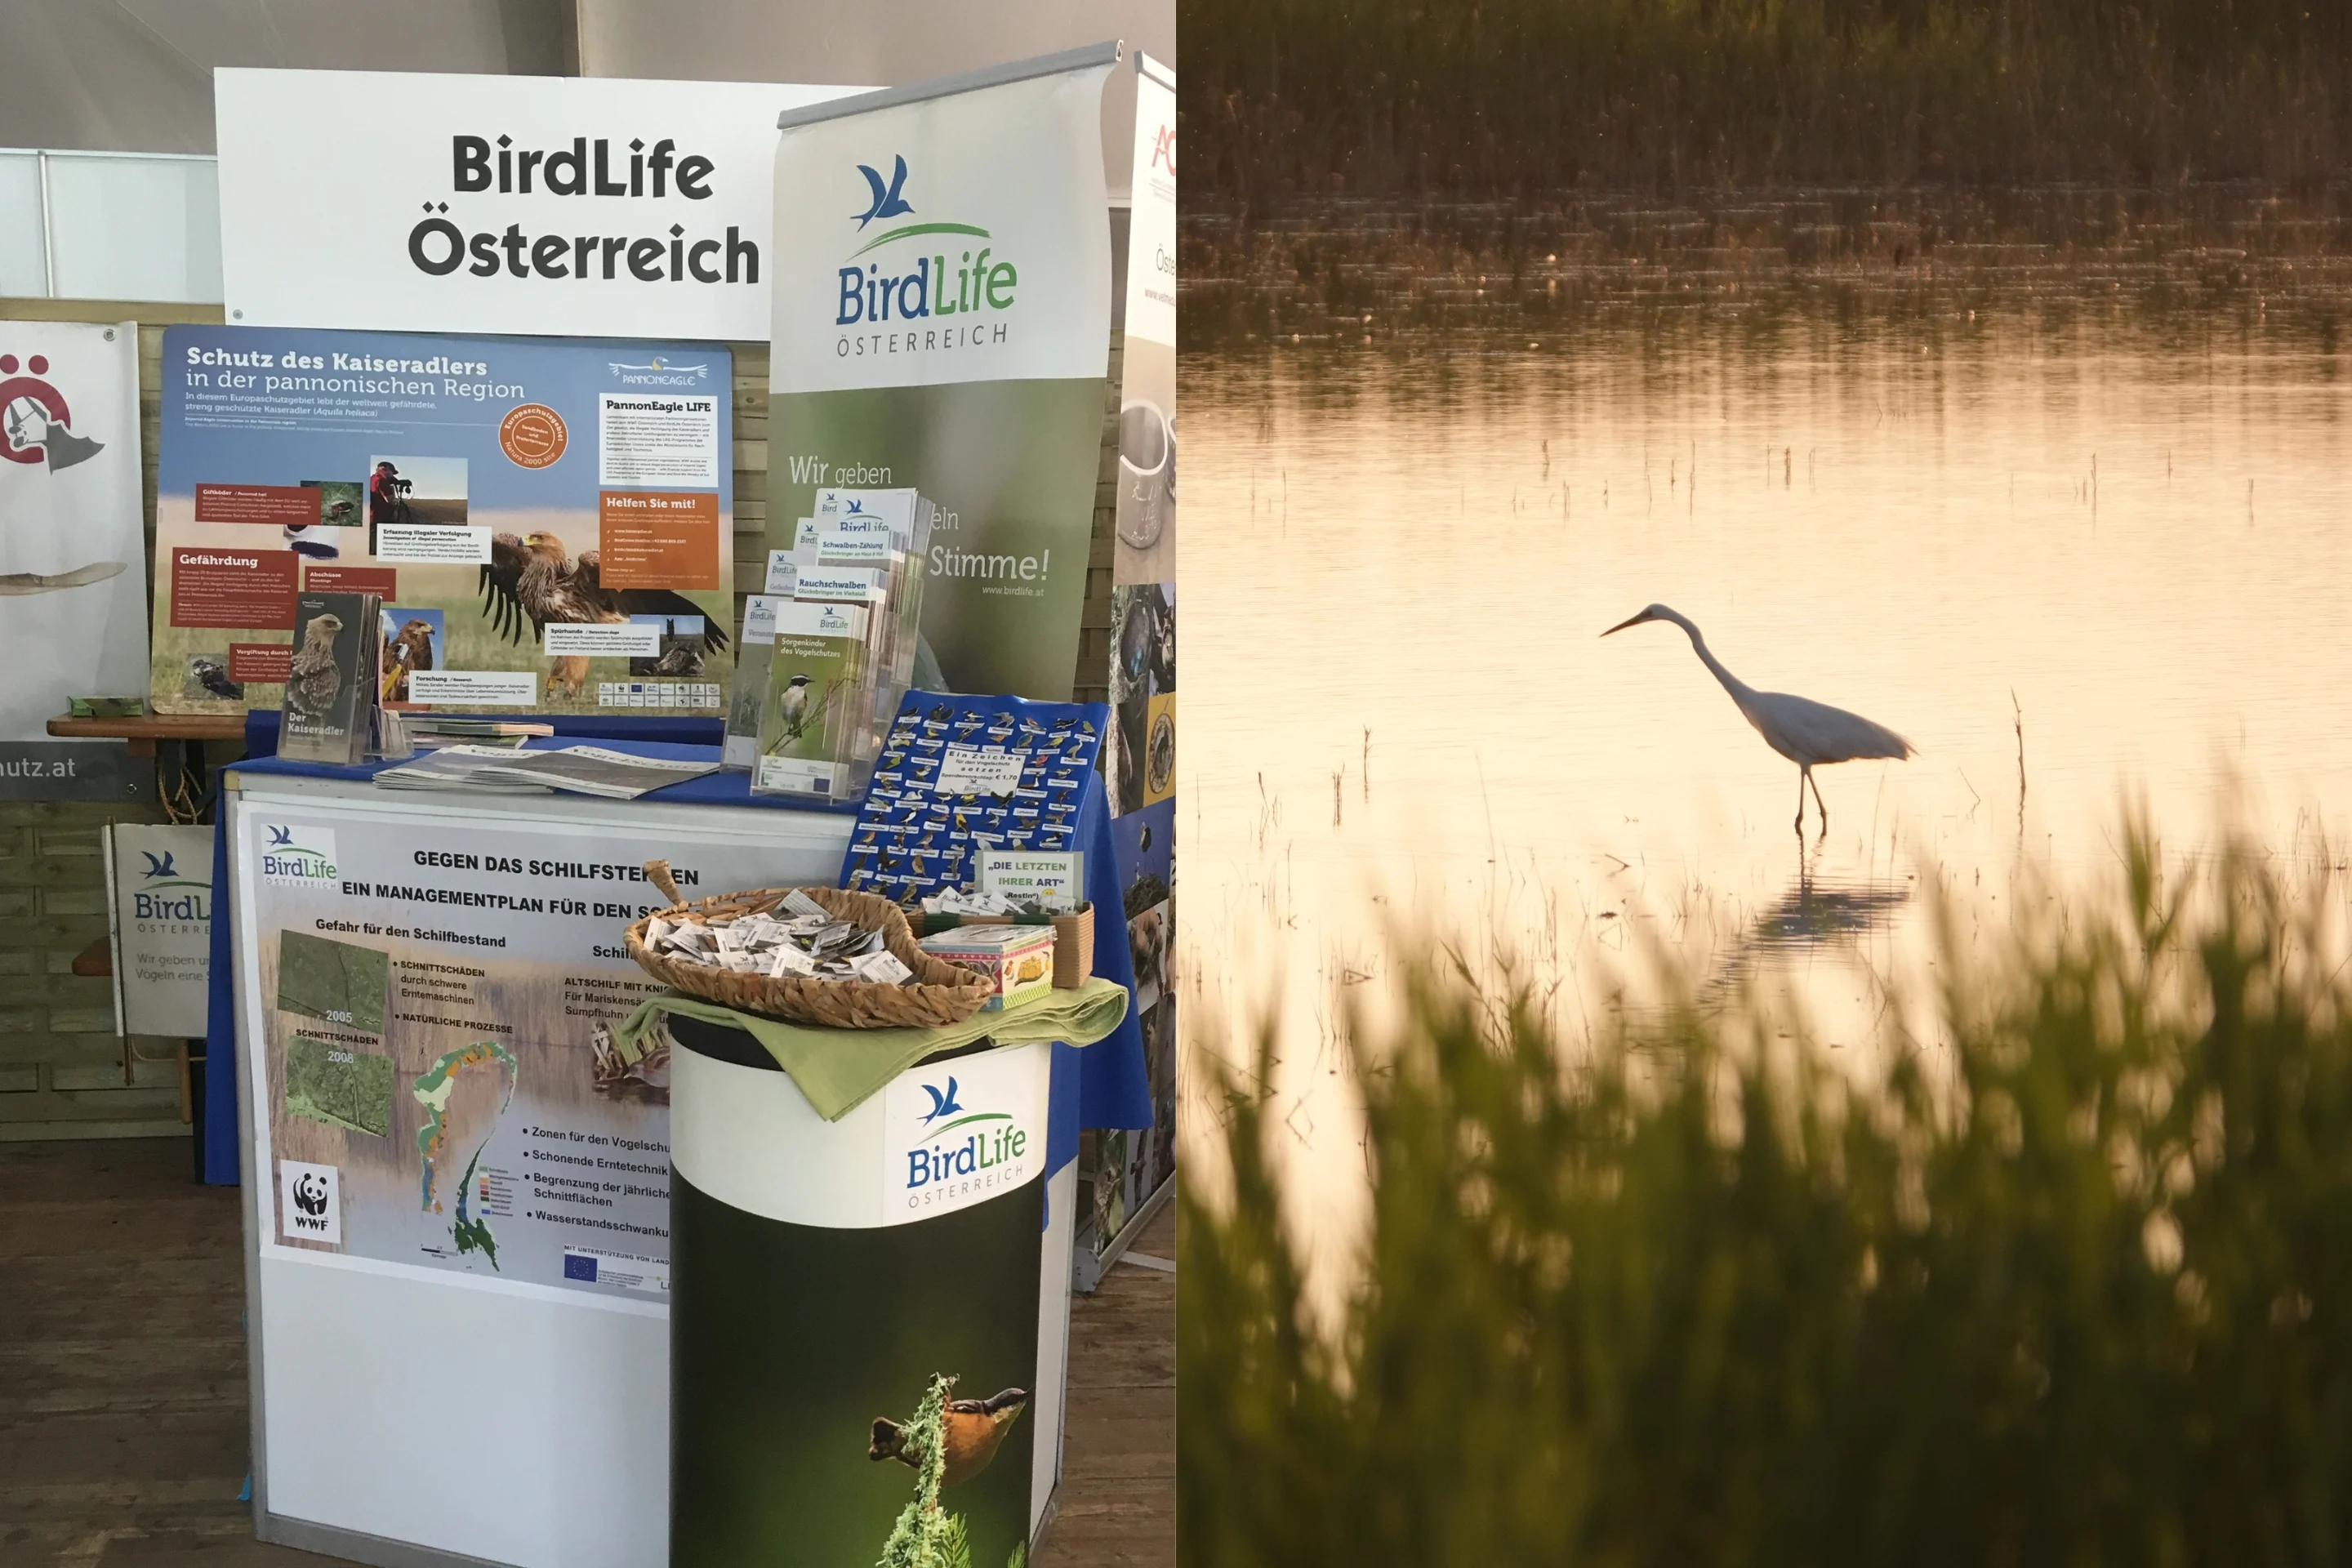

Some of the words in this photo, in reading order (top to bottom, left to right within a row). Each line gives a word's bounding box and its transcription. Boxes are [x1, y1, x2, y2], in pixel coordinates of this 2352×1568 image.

[453, 134, 715, 200] BirdLife
[408, 201, 759, 284] Österreich
[836, 247, 1017, 325] BirdLife
[837, 323, 1007, 357] ÖSTERREICH
[187, 347, 274, 367] Schutz
[282, 351, 324, 369] des
[332, 352, 488, 376] Kaiseradlers
[186, 369, 209, 386] in
[218, 371, 256, 388] der
[265, 375, 435, 394] pannonischen
[444, 379, 525, 401] Region
[622, 375, 695, 385] PANNONEAGLE
[197, 393, 227, 401] diesem
[230, 394, 314, 405] Europaschutzgebiet
[317, 397, 333, 405] lebt
[352, 399, 388, 407] weltweit
[606, 400, 684, 413] PannonEagle
[686, 403, 711, 412] LIFE
[185, 403, 212, 412] streng
[215, 403, 261, 412] geschützte
[265, 406, 311, 415] Kaiseradler
[313, 406, 343, 416] (Aquila
[505, 408, 564, 442] Europaschutzgebiet
[505, 441, 523, 462] Natura
[544, 452, 555, 462] site
[790, 456, 829, 484] Wir
[835, 462, 892, 489] geben
[607, 497, 647, 507] Helfen
[650, 498, 668, 508] Sie
[670, 499, 696, 509] mit!
[822, 504, 837, 512] Bird
[822, 541, 883, 550] Schwalben-Zählung
[180, 554, 259, 568] Gefährdung
[929, 546, 1049, 581] Stimme!
[772, 565, 797, 574] BirdLife
[800, 579, 866, 590] Rauchschwalben
[982, 586, 1045, 597] www.birdlife.at
[750, 612, 776, 620] BirdLife
[820, 619, 849, 629] BirdLife
[782, 638, 826, 648] Sorgenkinder
[781, 647, 793, 655] des
[795, 648, 840, 657] Vogelschutzes
[289, 713, 306, 721] Der
[287, 723, 344, 736] Kaiseradler
[949, 751, 968, 759] Ein
[971, 753, 1021, 761] Zeichen
[263, 856, 337, 880] BirdLife
[414, 850, 479, 870] GEGEN
[485, 856, 523, 874] DAS
[529, 860, 699, 885] SCHILFSTEEN
[988, 862, 1012, 871] „DIE
[1015, 862, 1067, 871] LETZTEN
[265, 877, 336, 889] ÖSTERREICH
[998, 877, 1033, 886] IHRER
[342, 881, 371, 897] EIN
[376, 884, 543, 913] MANAGEMENTPLAN
[550, 898, 587, 915] FÜR
[593, 902, 632, 919] DEN
[316, 919, 360, 933] Gefahr
[363, 923, 382, 936] für
[385, 925, 410, 938] den
[413, 928, 506, 948] Schilfbestand
[137, 953, 154, 964] Wir
[158, 955, 195, 967] geben
[135, 969, 175, 982] Vögeln
[178, 970, 203, 981] eine
[400, 961, 485, 978] SCHNITTSCHÄDEN
[400, 975, 427, 986] durch
[429, 978, 467, 991] schwere
[565, 978, 621, 989] ALTSCHILF
[624, 982, 642, 991] MIT
[402, 988, 474, 1004] Erntemaschinen
[565, 991, 582, 1001] Für
[327, 1009, 353, 1022] 2005
[565, 1005, 623, 1019] Sumpfhuhn
[403, 1013, 462, 1027] NATÜRLICHE
[464, 1021, 514, 1034] PROZESSE
[296, 1028, 379, 1045] SCHNITTSCHÄDEN
[327, 1051, 354, 1063] 2008
[532, 1126, 566, 1140] Zonen
[569, 1131, 586, 1143] für
[588, 1134, 608, 1146] den
[532, 1149, 594, 1167] Schonende
[597, 1158, 668, 1176] Erntetechnik
[906, 1125, 1026, 1188] BirdLife
[533, 1173, 599, 1192] Begrenzung
[603, 1182, 621, 1192] der
[908, 1164, 1023, 1209] ÖSTERREICH
[534, 1187, 612, 1207] Schnittflächen
[295, 1216, 329, 1232] WWF
[536, 1209, 669, 1237] Wasserstandsschwanku
[578, 1247, 635, 1260] UNTERSTÜTZUNG
